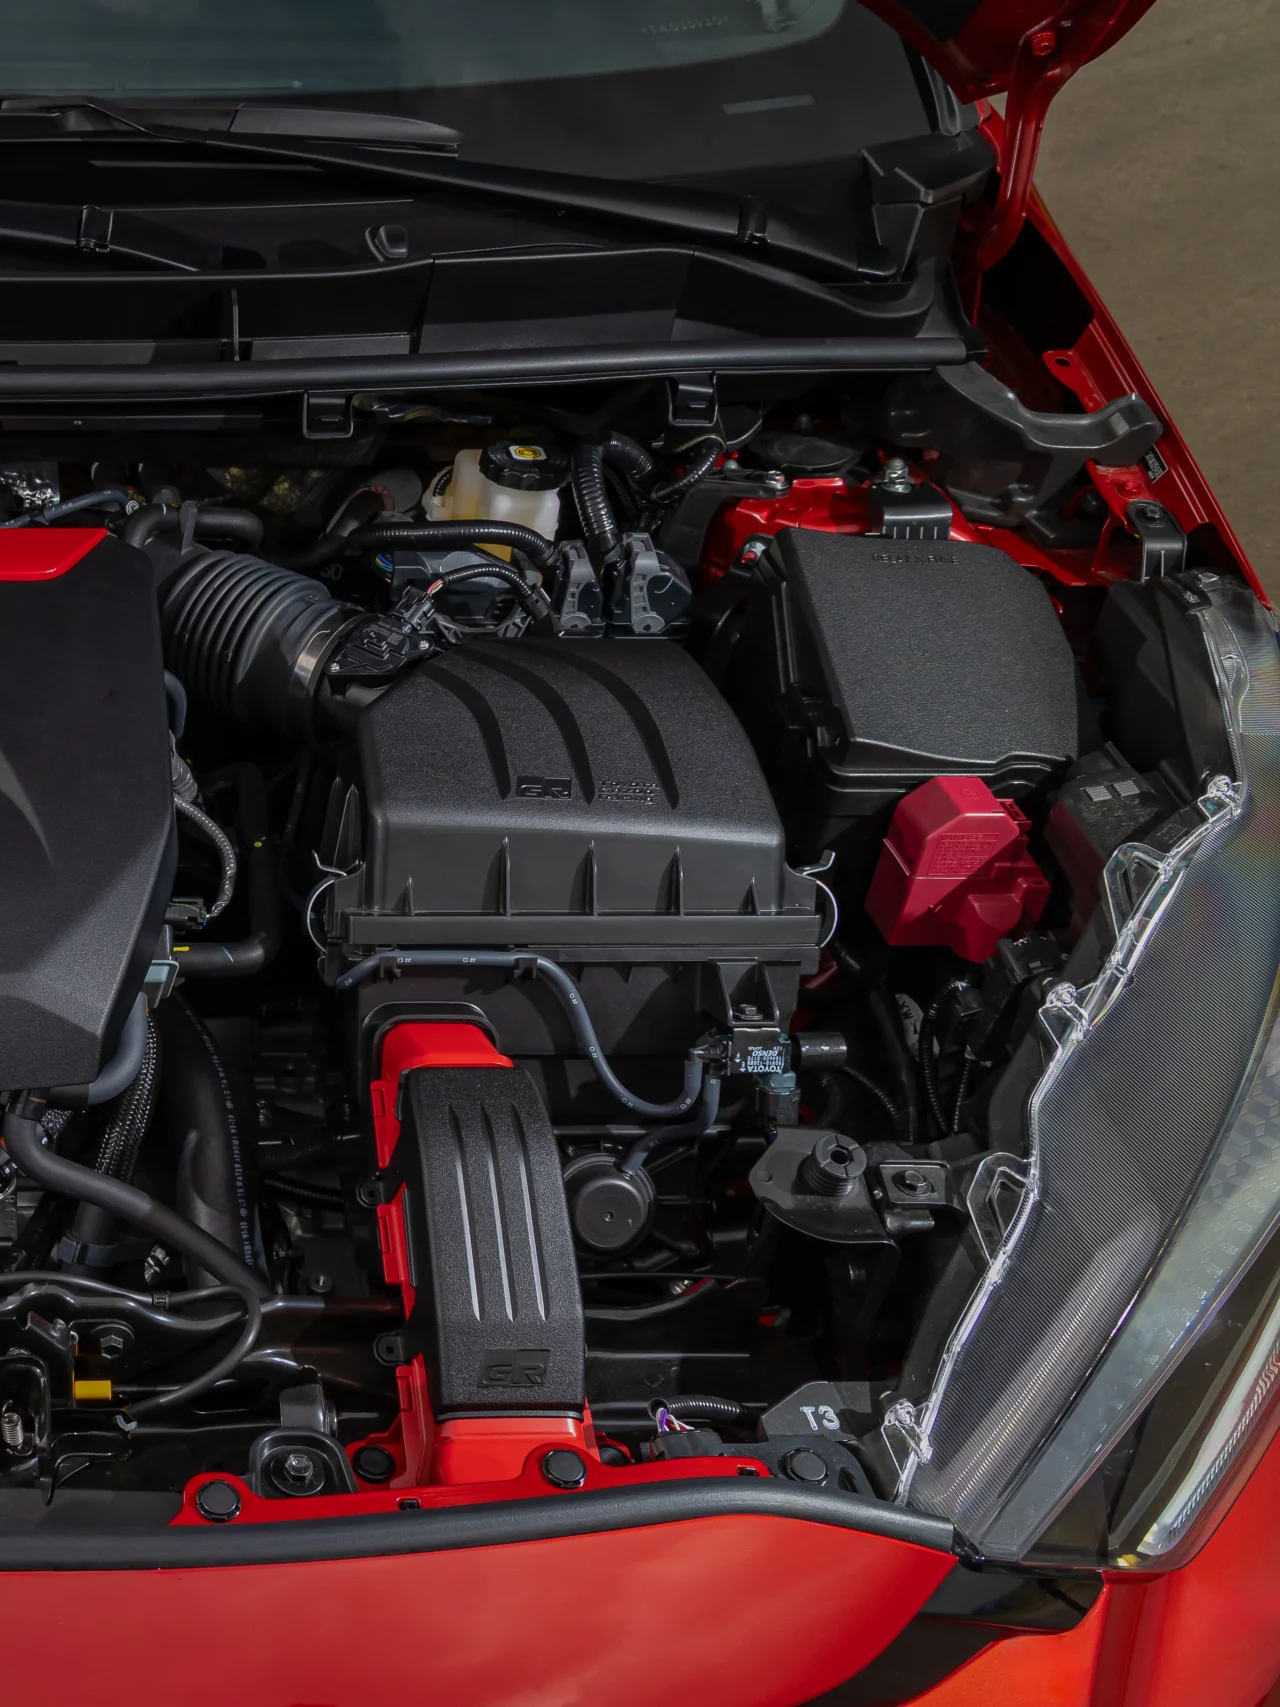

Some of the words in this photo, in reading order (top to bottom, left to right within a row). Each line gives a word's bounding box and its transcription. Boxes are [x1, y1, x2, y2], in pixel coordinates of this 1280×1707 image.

[519, 783, 570, 799] GR
[747, 1065, 782, 1073] TOYOTA
[481, 1364, 545, 1385] GR
[799, 1405, 840, 1431] T3
